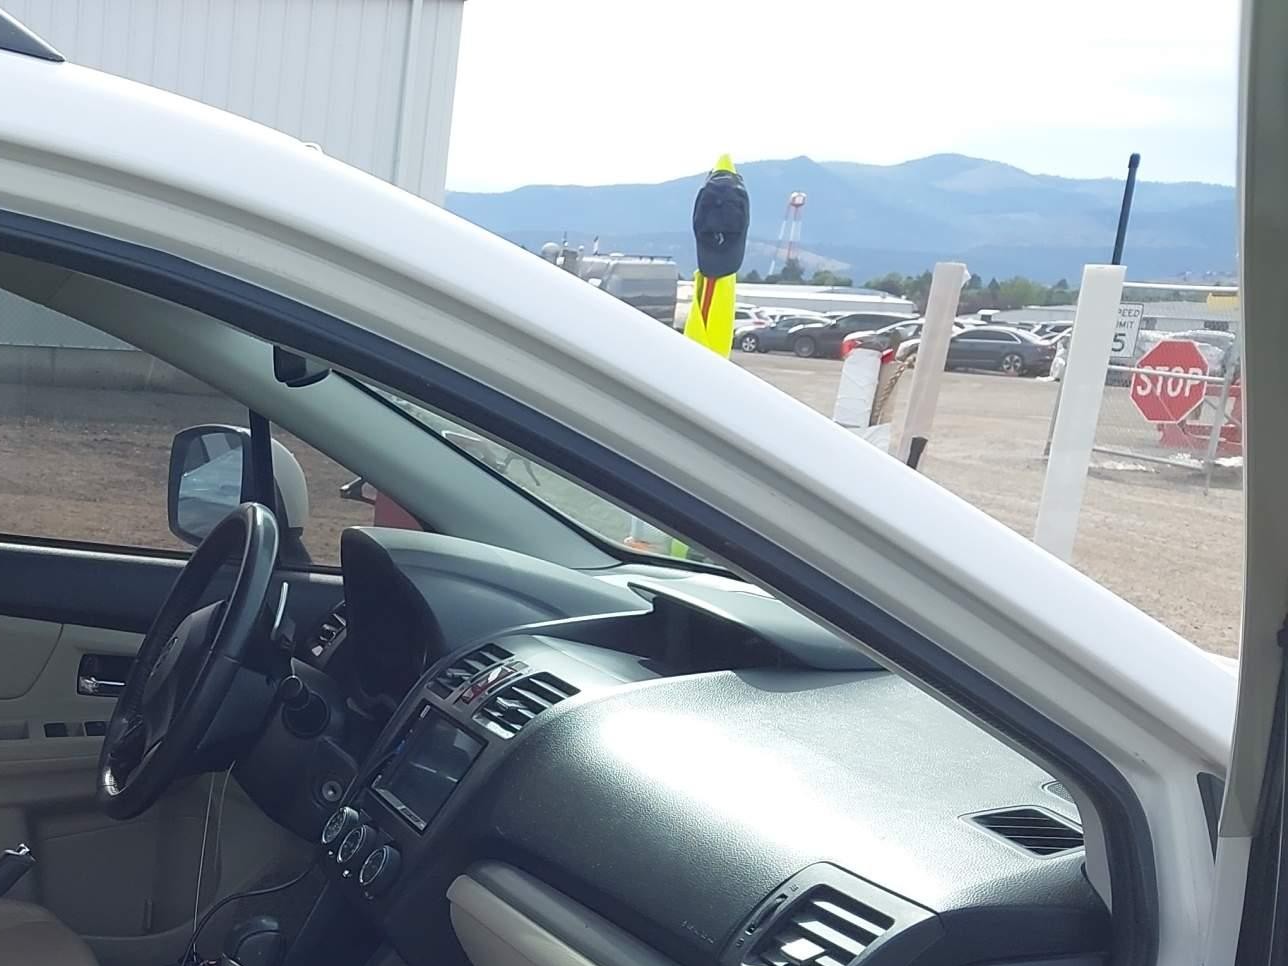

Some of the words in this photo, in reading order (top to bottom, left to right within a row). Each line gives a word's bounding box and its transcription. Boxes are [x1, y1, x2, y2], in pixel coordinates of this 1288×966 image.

[1118, 309, 1140, 317] EED
[1116, 320, 1134, 329] IMIT
[1136, 366, 1203, 397] STOP
